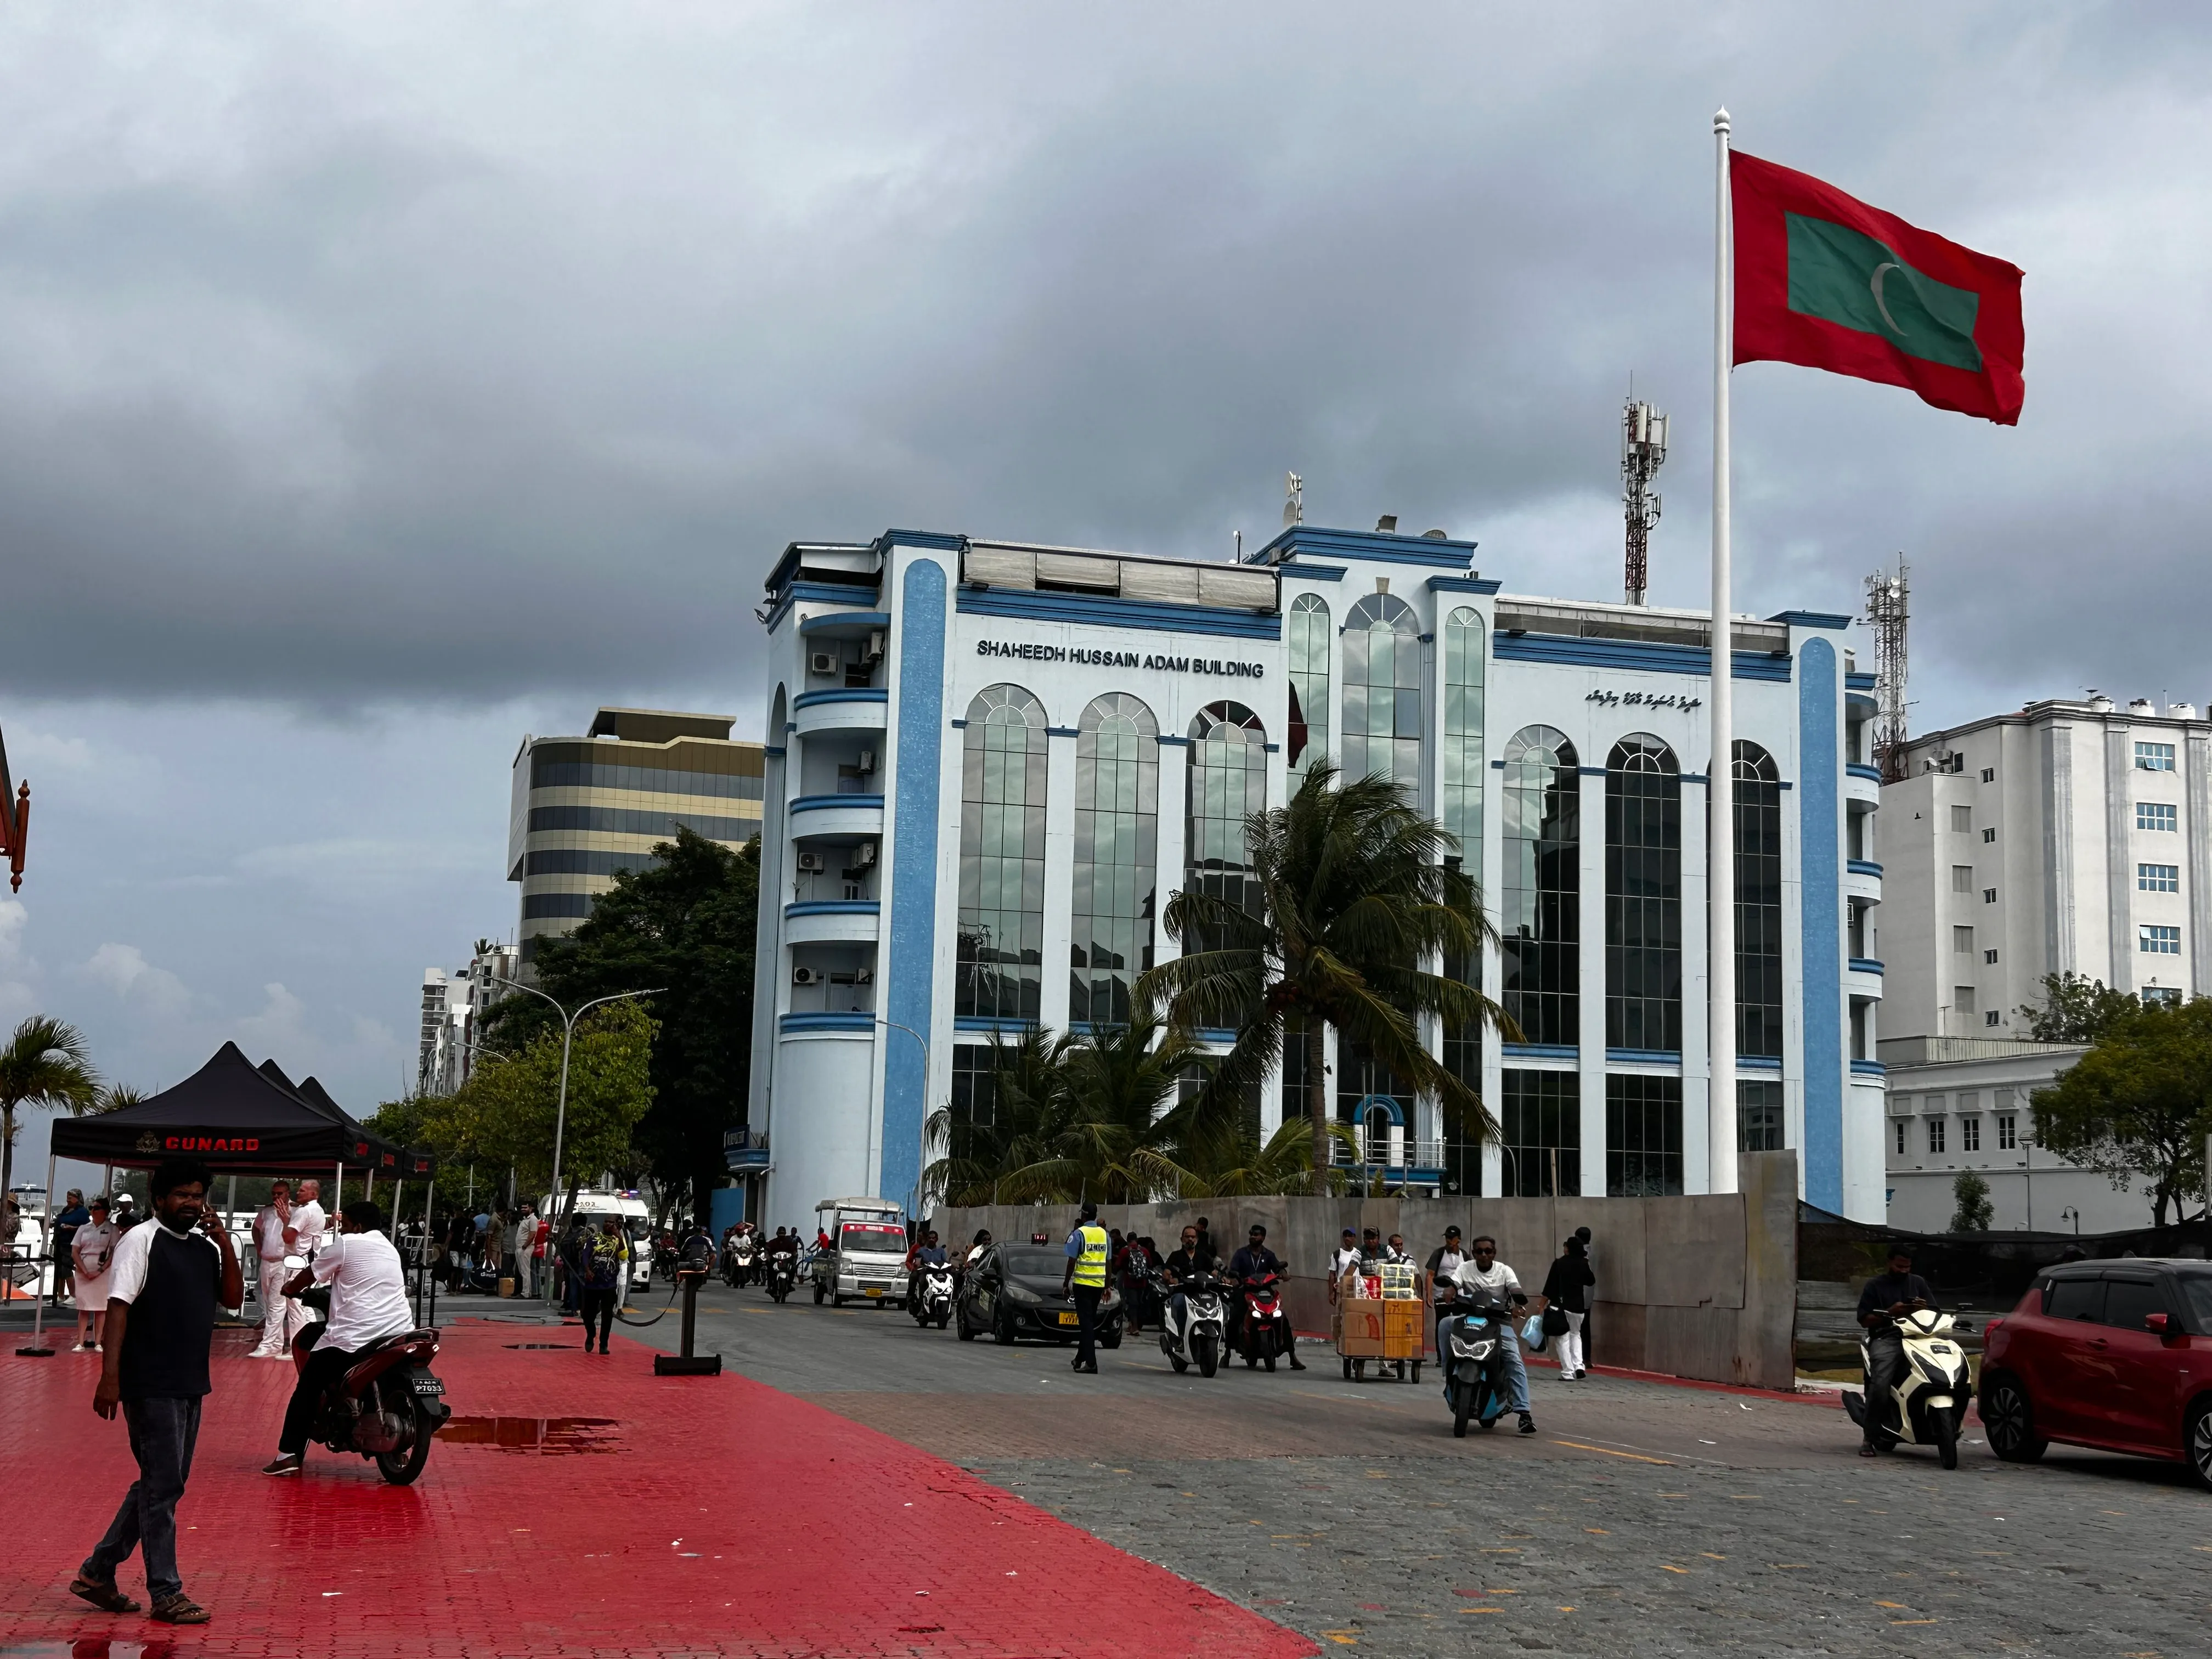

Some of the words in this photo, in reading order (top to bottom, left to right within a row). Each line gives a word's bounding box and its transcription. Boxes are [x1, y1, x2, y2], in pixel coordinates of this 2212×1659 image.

[977, 639, 1065, 662] SHAHEEDH
[1069, 648, 1139, 668] HUSSAIN
[1143, 654, 1189, 673] ADAM
[1193, 658, 1264, 679] BUILDING
[166, 1137, 259, 1151] CUNARD
